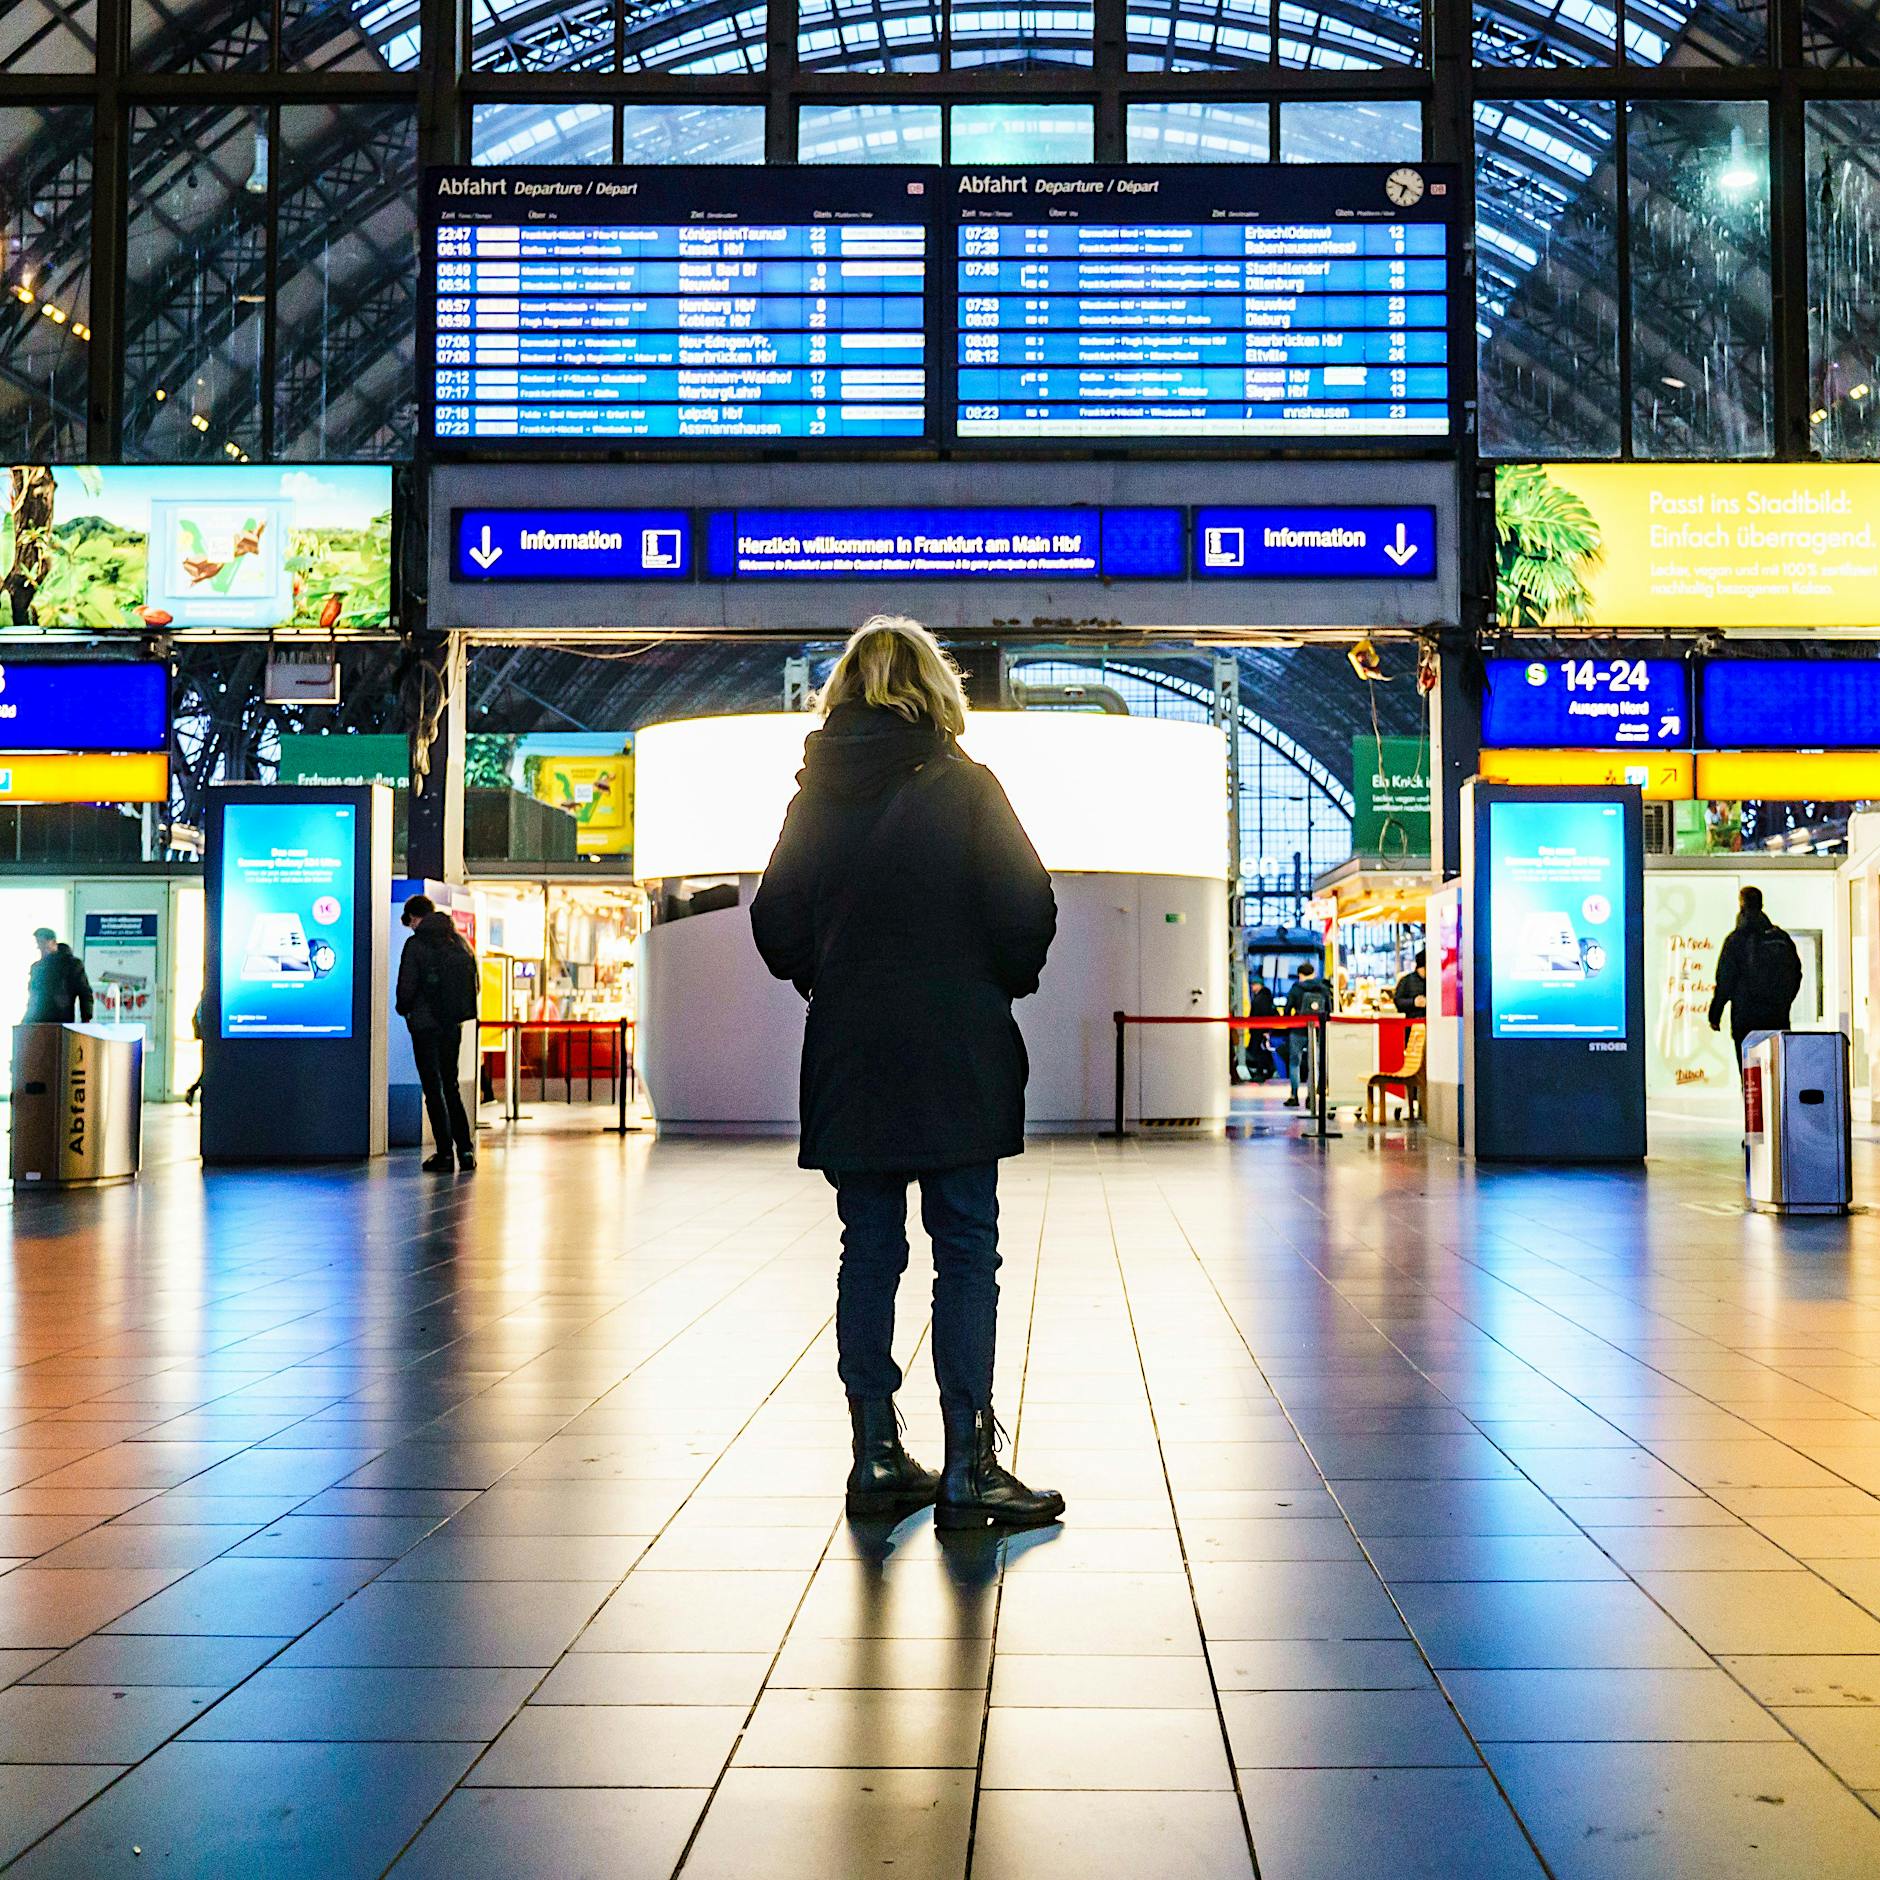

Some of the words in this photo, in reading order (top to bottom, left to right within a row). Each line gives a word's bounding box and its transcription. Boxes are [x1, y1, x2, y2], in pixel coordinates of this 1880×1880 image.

[438, 178, 506, 195] Abfahrt
[515, 182, 582, 197] Departure
[596, 183, 637, 196] Départ
[959, 176, 1027, 193] Abfahrt
[1035, 179, 1104, 195] Departure
[1117, 180, 1159, 194] Départ
[810, 227, 825, 240] 22
[966, 263, 998, 275] 07:45
[810, 313, 826, 327] 22
[1322, 334, 1342, 346] Hbf
[756, 351, 776, 363] Hbf
[437, 372, 469, 383] 07:12
[811, 371, 825, 383] 17
[1290, 370, 1309, 382] Hbf
[437, 386, 469, 398] 07:17
[1288, 385, 1308, 397] Hbf
[723, 408, 742, 419] Hbf
[437, 422, 468, 434] 07:23
[680, 420, 780, 434] Assmannshausen
[811, 422, 825, 434] 23
[1650, 491, 1704, 515] Passt
[1711, 493, 1741, 515] ins
[1746, 490, 1852, 515] Stadtbild:
[521, 530, 621, 549] Information
[1265, 528, 1365, 547] Information
[1650, 523, 1729, 548] Einfach
[1737, 523, 1877, 556] überragend.
[739, 537, 800, 554] Herzlich
[803, 537, 894, 553] willkommen
[897, 537, 912, 553] in
[915, 536, 983, 553] Frankfurt
[985, 539, 1010, 552] am
[1013, 536, 1050, 552] Main
[1053, 536, 1081, 552] Hbf
[1561, 660, 1649, 691] 14-24
[1569, 701, 1619, 717] Ausgang
[1620, 702, 1649, 715] Nord
[69, 1069, 86, 1156] Abfall
